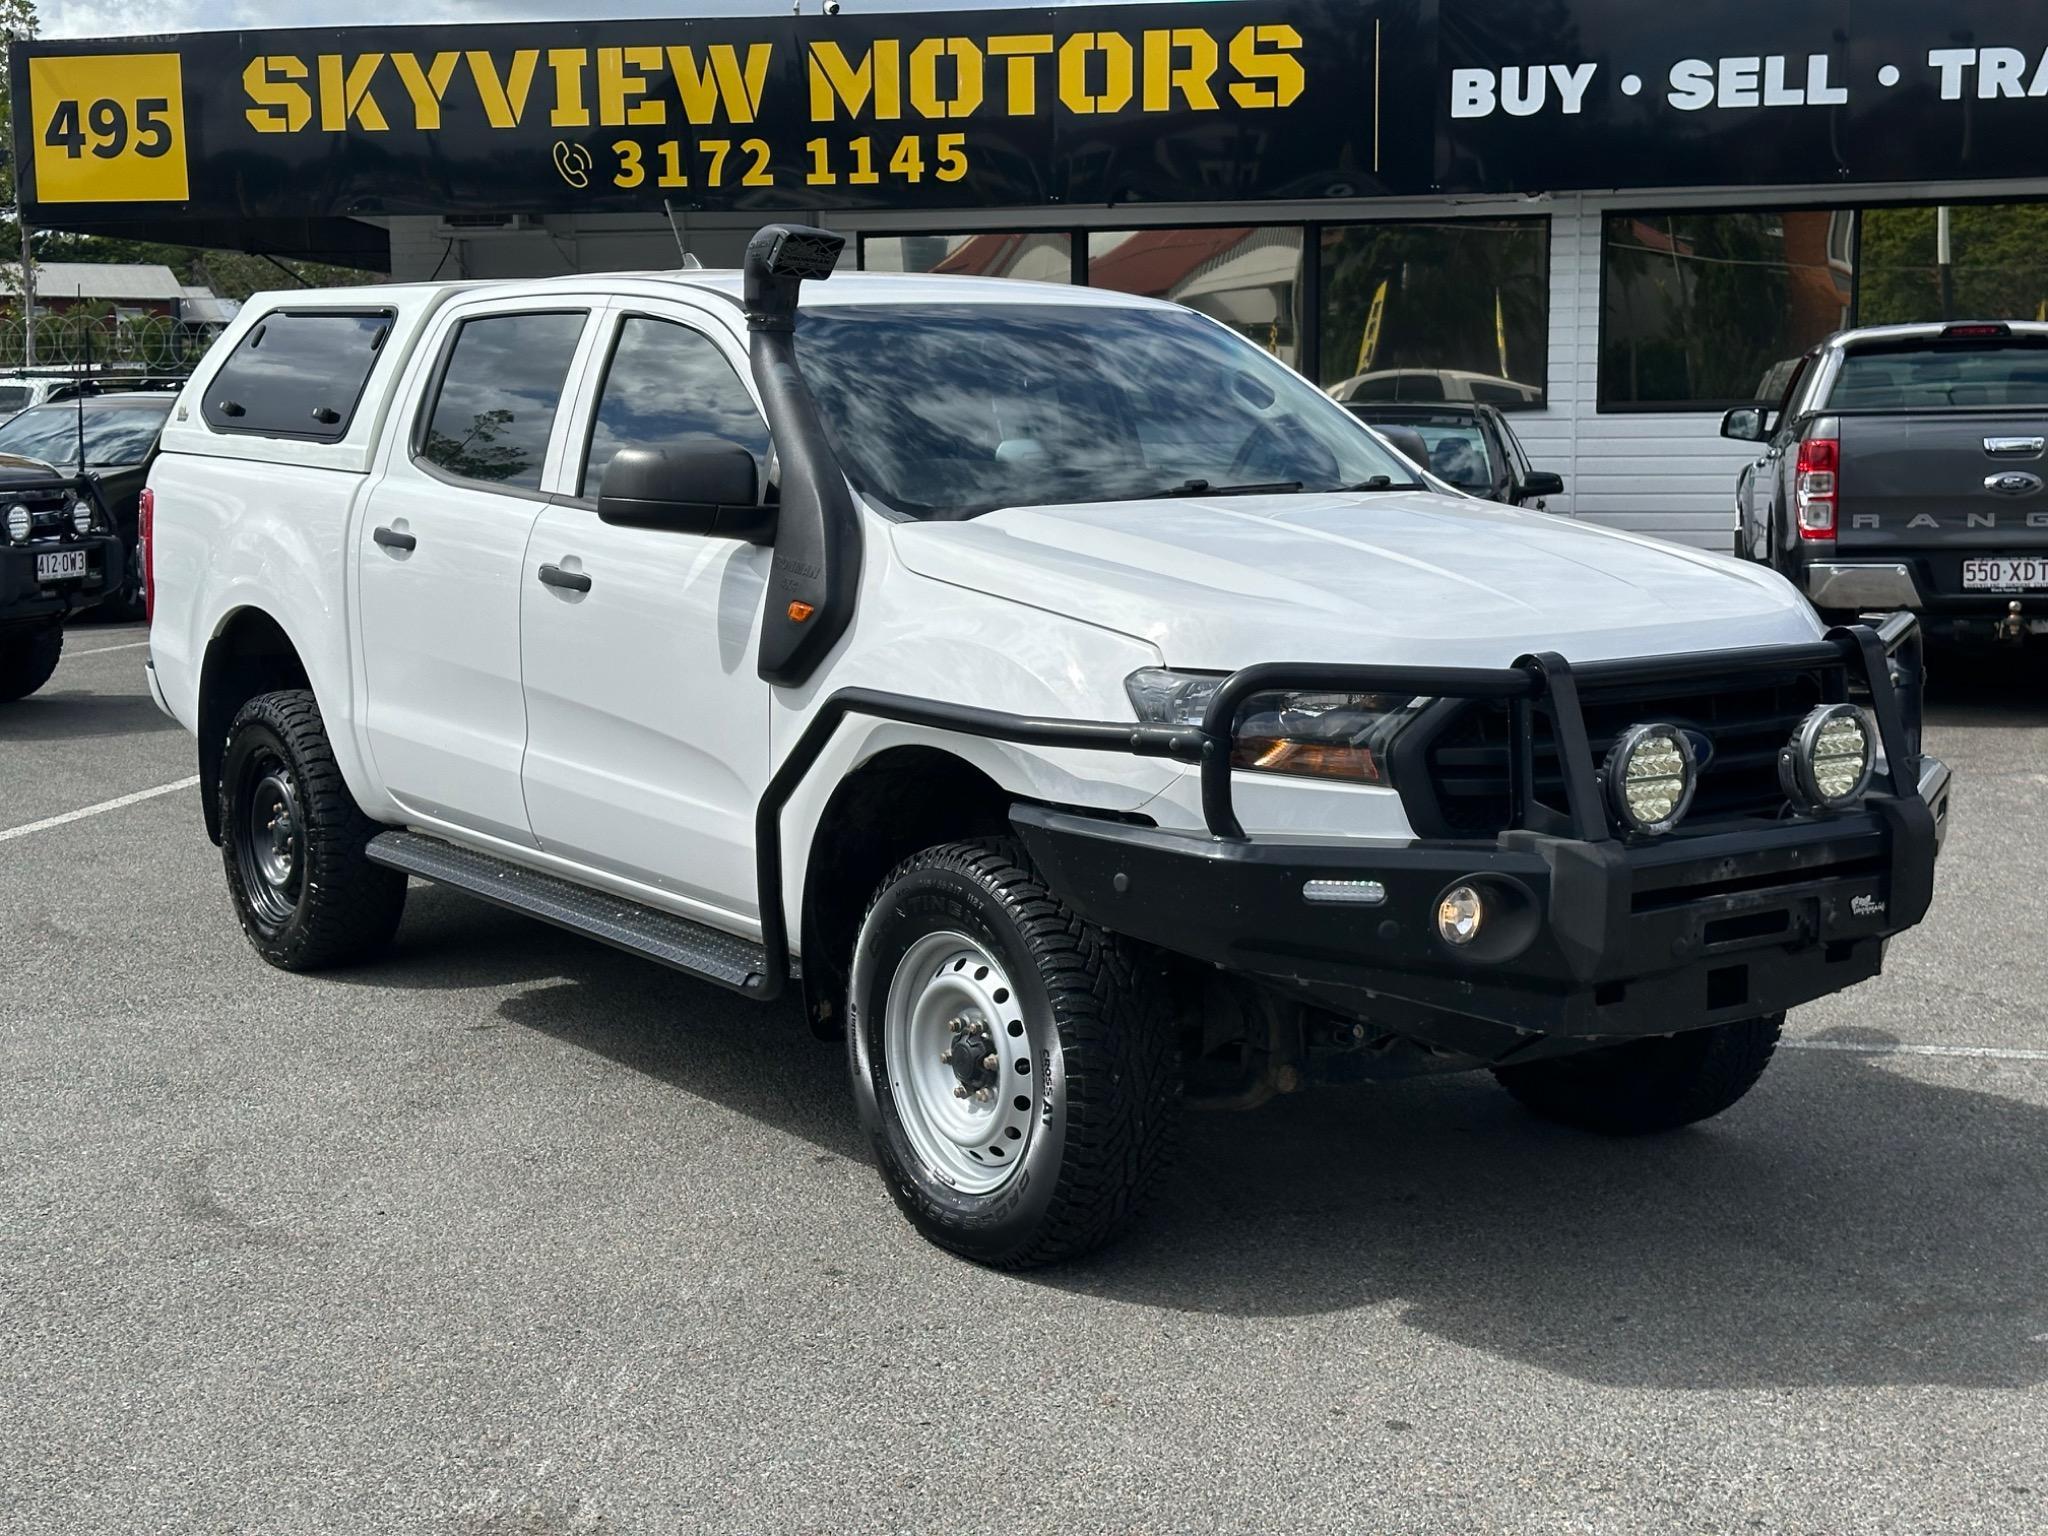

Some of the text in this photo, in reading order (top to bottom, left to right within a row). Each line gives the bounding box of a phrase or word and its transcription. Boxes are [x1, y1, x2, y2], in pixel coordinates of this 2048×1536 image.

[243, 25, 1305, 132] SKYVIEW MOTORS
[1452, 64, 1597, 118] BUY
[1668, 55, 1848, 110] SELL
[44, 98, 173, 159] 495
[614, 133, 968, 188] 3172 1145
[1042, 1098, 1053, 1131] AT
